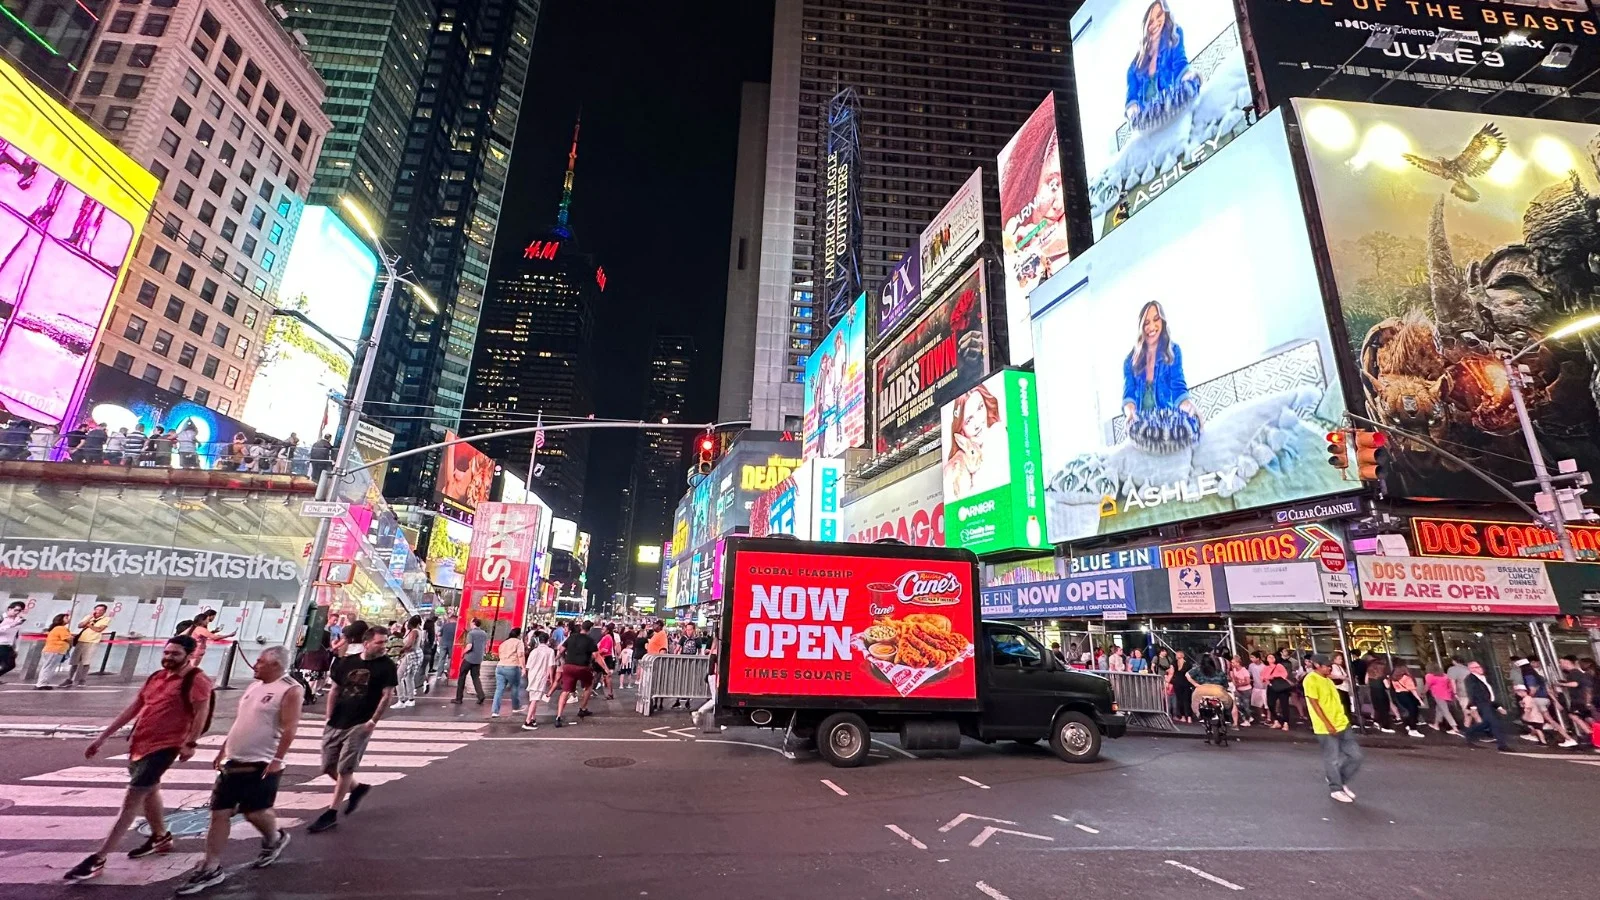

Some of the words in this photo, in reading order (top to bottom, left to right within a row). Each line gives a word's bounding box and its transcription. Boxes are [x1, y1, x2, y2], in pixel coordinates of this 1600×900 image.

[1406, 1, 1464, 20] THE
[1482, 9, 1597, 35] BEASTS
[1481, 50, 1505, 67] 9
[826, 150, 838, 198] EAGLE
[1132, 130, 1222, 212] ASHLEY
[836, 163, 849, 256] OUTFITTERS
[523, 240, 560, 261] H&M
[825, 200, 837, 279] AMERICAN
[880, 332, 957, 420] HADESTOWN
[1124, 467, 1238, 512] ASHLEY
[1164, 548, 1198, 568] DOS
[1202, 534, 1297, 564] CAMINOS
[1421, 522, 1481, 554] DOS
[749, 566, 793, 576] GLOBAL
[798, 568, 853, 578] FLAGSHIP
[1071, 552, 1112, 573] BLUE
[1119, 547, 1150, 567] FIN
[1372, 562, 1405, 580] DOS
[1411, 563, 1486, 583] CAMINOS
[1497, 566, 1540, 574] BREAKFAST
[898, 570, 959, 602] Cane's
[994, 591, 1011, 604] FIN
[1018, 585, 1061, 605] NOW
[1066, 578, 1126, 603] OPEN
[1365, 582, 1397, 597] WE
[1404, 583, 1441, 598] ARE
[1448, 584, 1500, 600] OPEN
[749, 584, 850, 622] NOW
[1102, 602, 1127, 610] COCKTAILS
[744, 622, 853, 661] OPEN
[744, 668, 788, 679] TIMES
[794, 669, 852, 681] SQUARE
